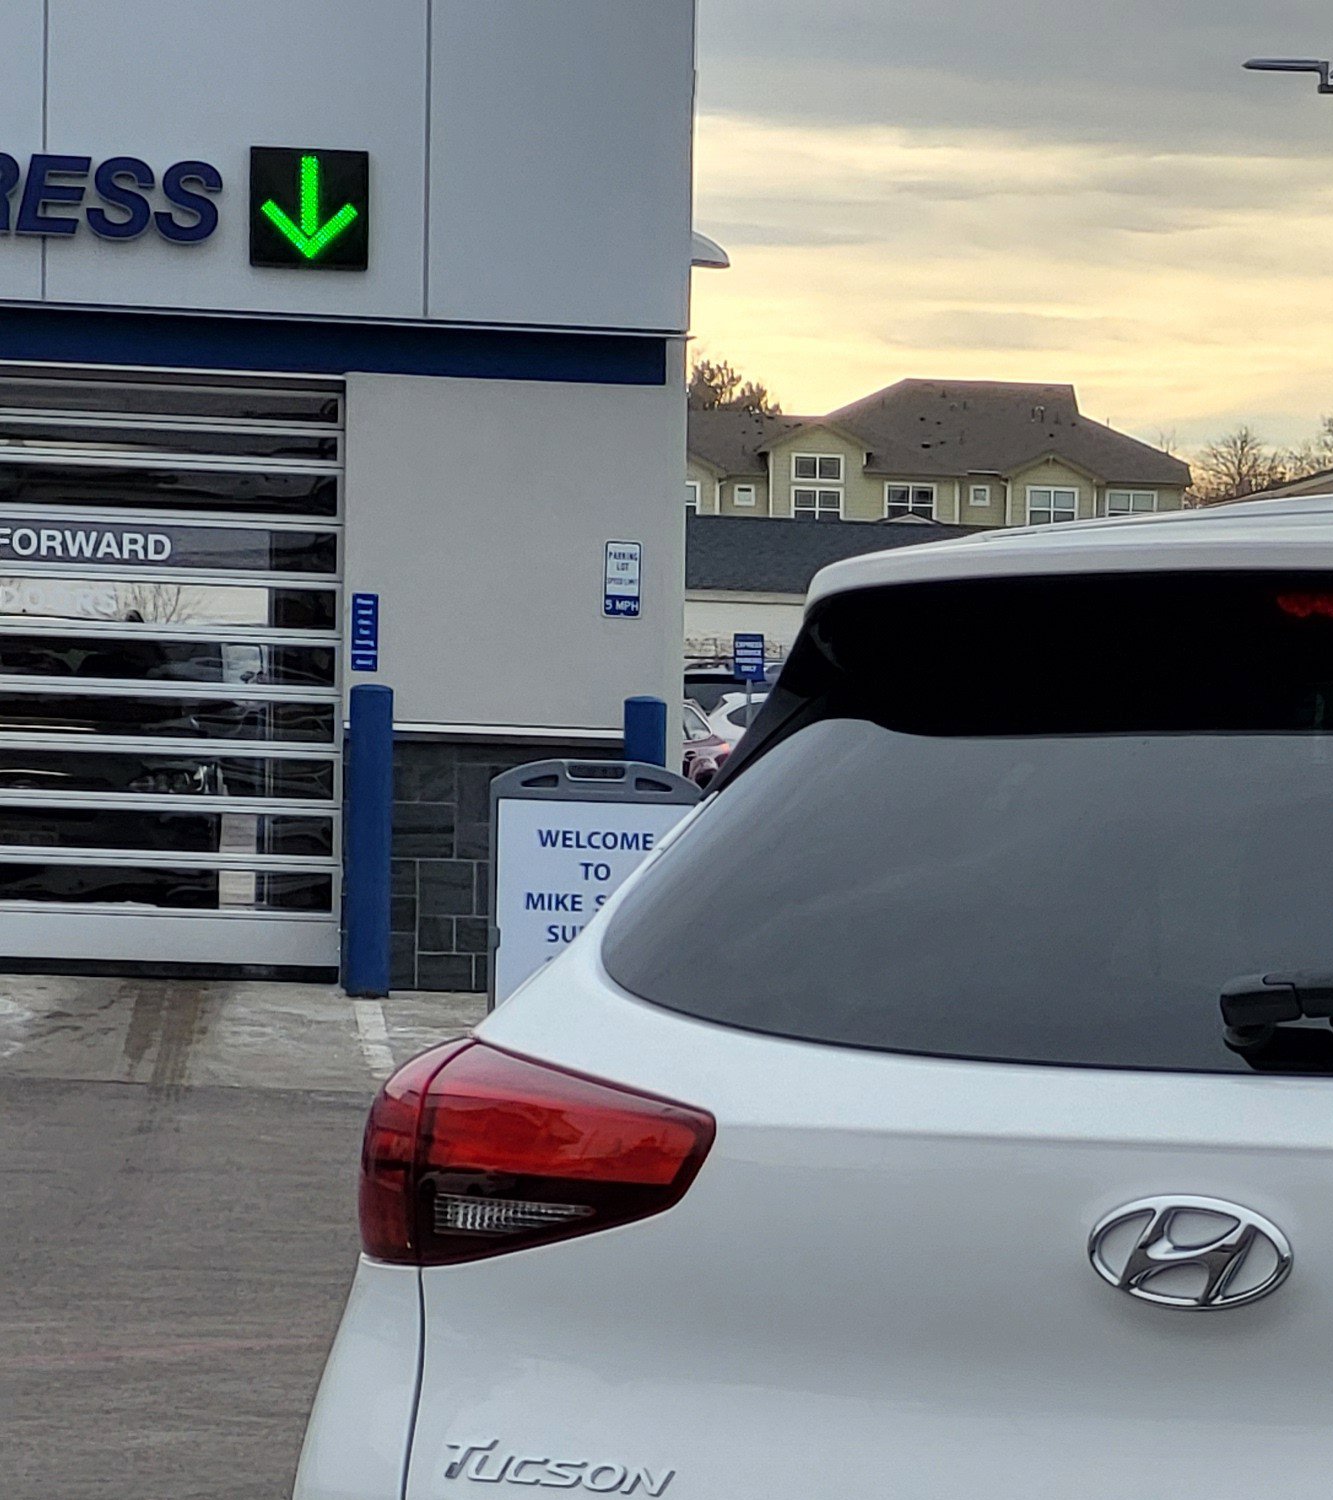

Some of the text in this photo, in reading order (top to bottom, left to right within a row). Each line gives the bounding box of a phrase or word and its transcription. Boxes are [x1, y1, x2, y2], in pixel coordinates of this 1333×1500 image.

[605, 599, 639, 612] 5 MPH
[537, 828, 654, 851] WELCOME
[579, 862, 611, 881] TO
[524, 892, 583, 912] MIKE
